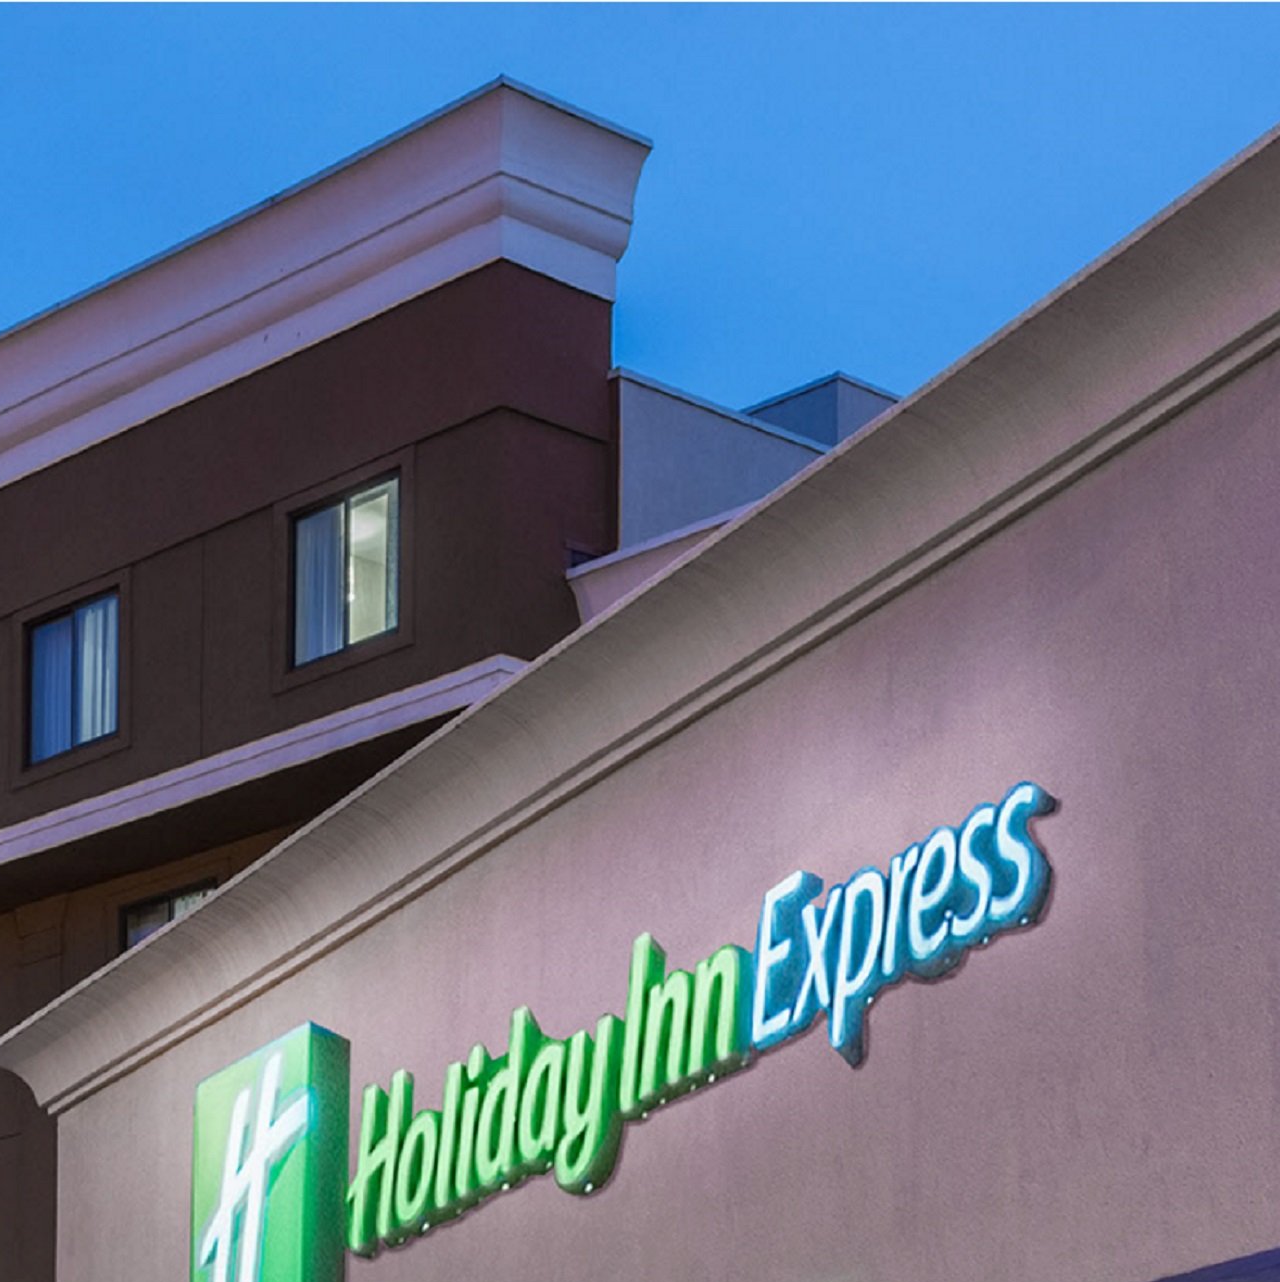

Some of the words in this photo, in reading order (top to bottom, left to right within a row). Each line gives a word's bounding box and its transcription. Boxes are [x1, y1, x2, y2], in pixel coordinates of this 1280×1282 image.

[347, 1005, 623, 1252] Holiday
[620, 932, 750, 1116] Inn
[751, 781, 1055, 1064] Express
